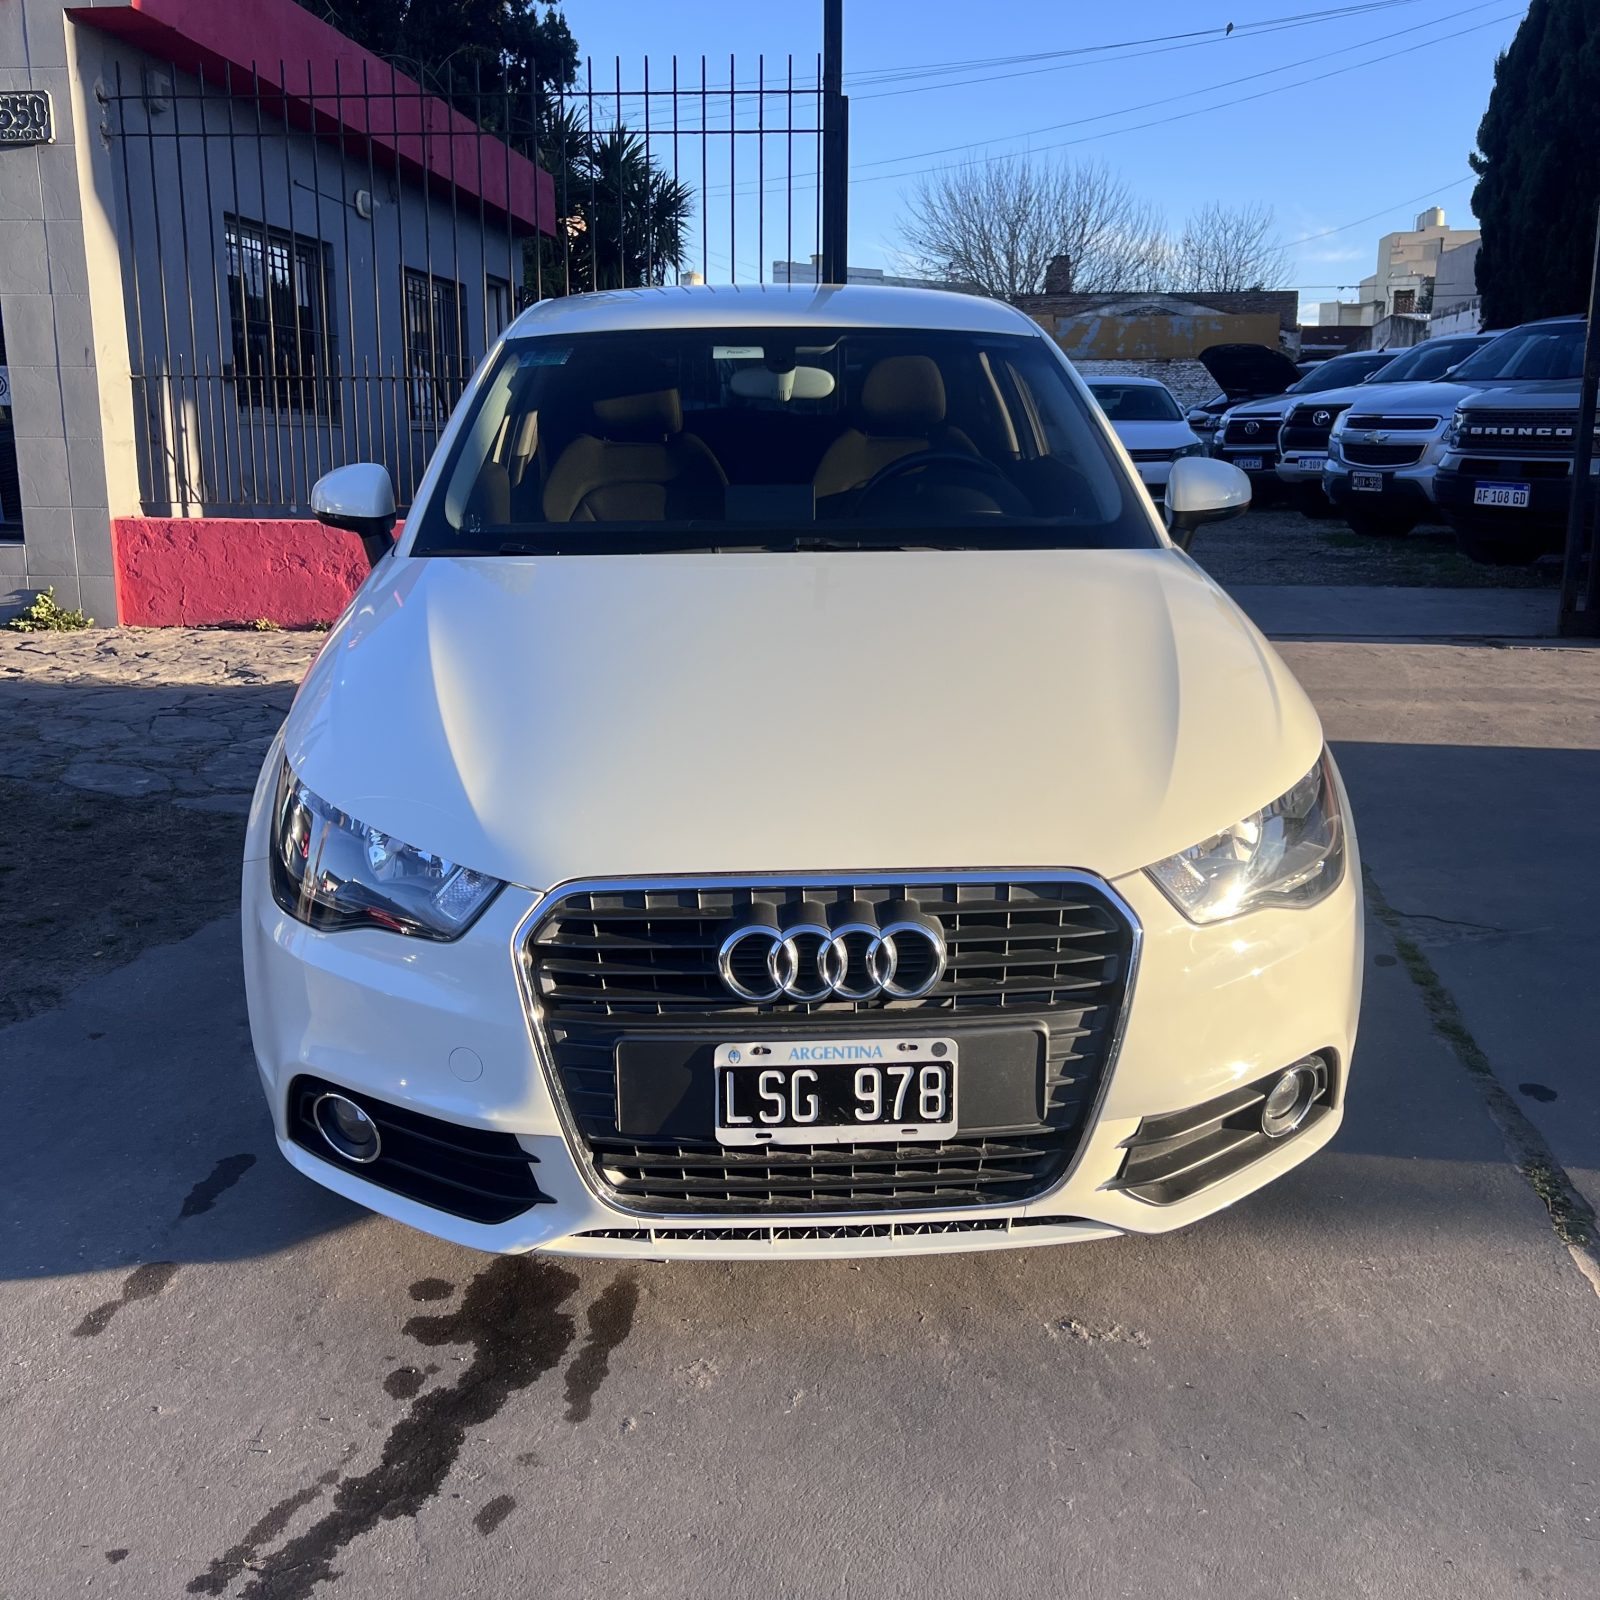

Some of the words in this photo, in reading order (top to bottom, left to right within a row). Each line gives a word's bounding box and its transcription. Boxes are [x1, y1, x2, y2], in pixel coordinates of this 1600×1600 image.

[1470, 427, 1573, 436] BRONCO
[1476, 489, 1489, 502] AF
[1491, 490, 1510, 504] 108
[1512, 491, 1526, 505] GD
[788, 1045, 883, 1061] ARGENTINA
[726, 1069, 819, 1124] LSG
[854, 1066, 946, 1121] 978
